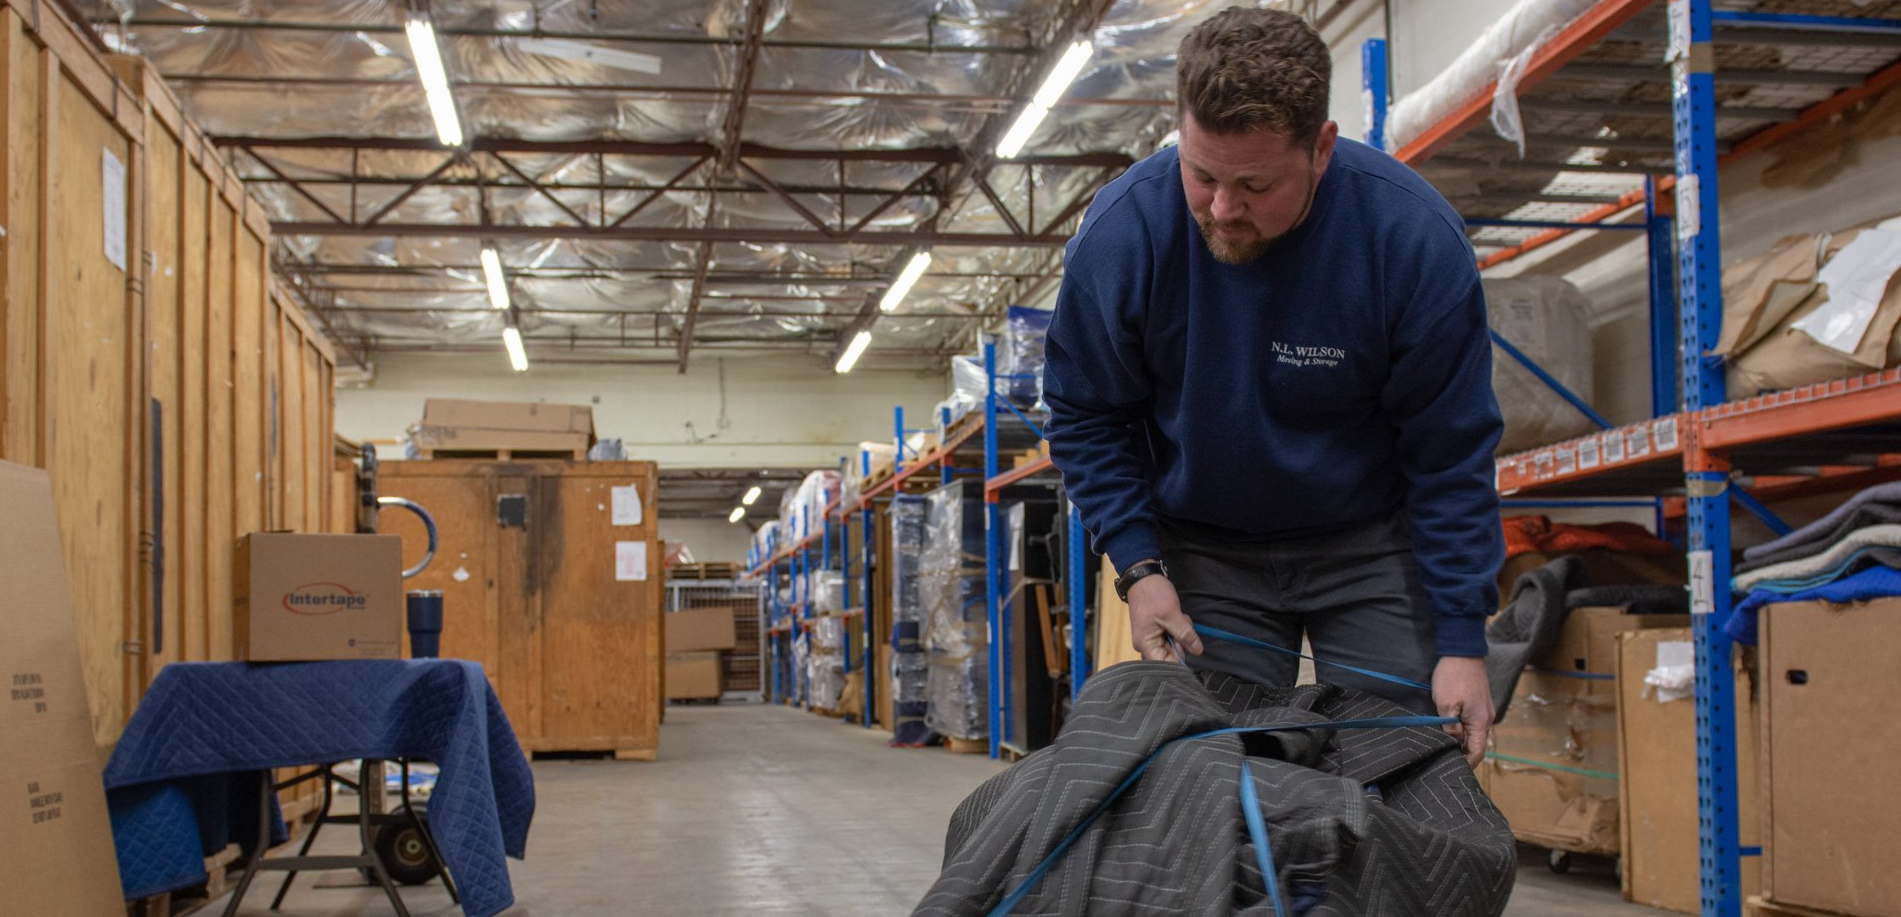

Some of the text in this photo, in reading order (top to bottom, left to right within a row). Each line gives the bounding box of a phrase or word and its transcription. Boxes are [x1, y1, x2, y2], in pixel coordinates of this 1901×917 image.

[1271, 341, 1345, 359] N.L. WILSON
[1276, 354, 1338, 367] Moving & Storage
[289, 592, 366, 609] Intertape
